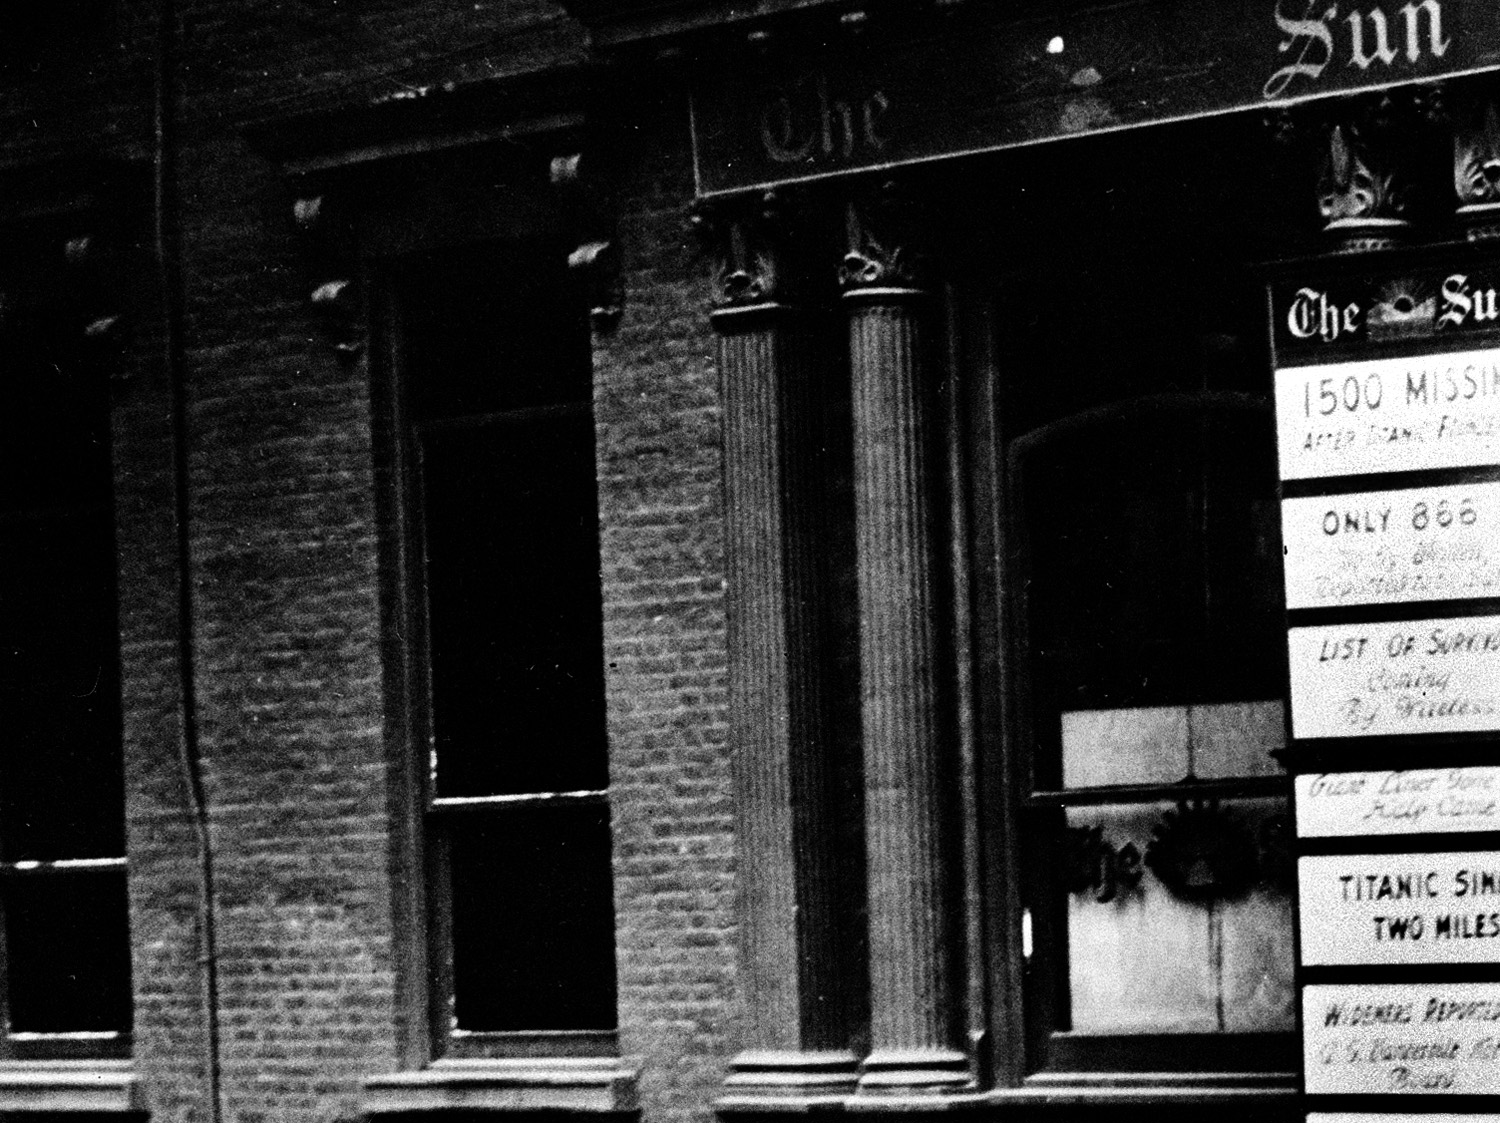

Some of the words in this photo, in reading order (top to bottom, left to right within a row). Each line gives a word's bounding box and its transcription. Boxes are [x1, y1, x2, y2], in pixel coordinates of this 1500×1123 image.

[1263, 0, 1450, 98] Sun
[1287, 287, 1360, 342] The
[1303, 373, 1383, 417] 1500
[1322, 506, 1392, 536] ONLY
[1411, 499, 1478, 531] 866
[1318, 636, 1368, 662] LIST
[1339, 872, 1438, 900] TITANIC
[1372, 914, 1424, 941] TWO
